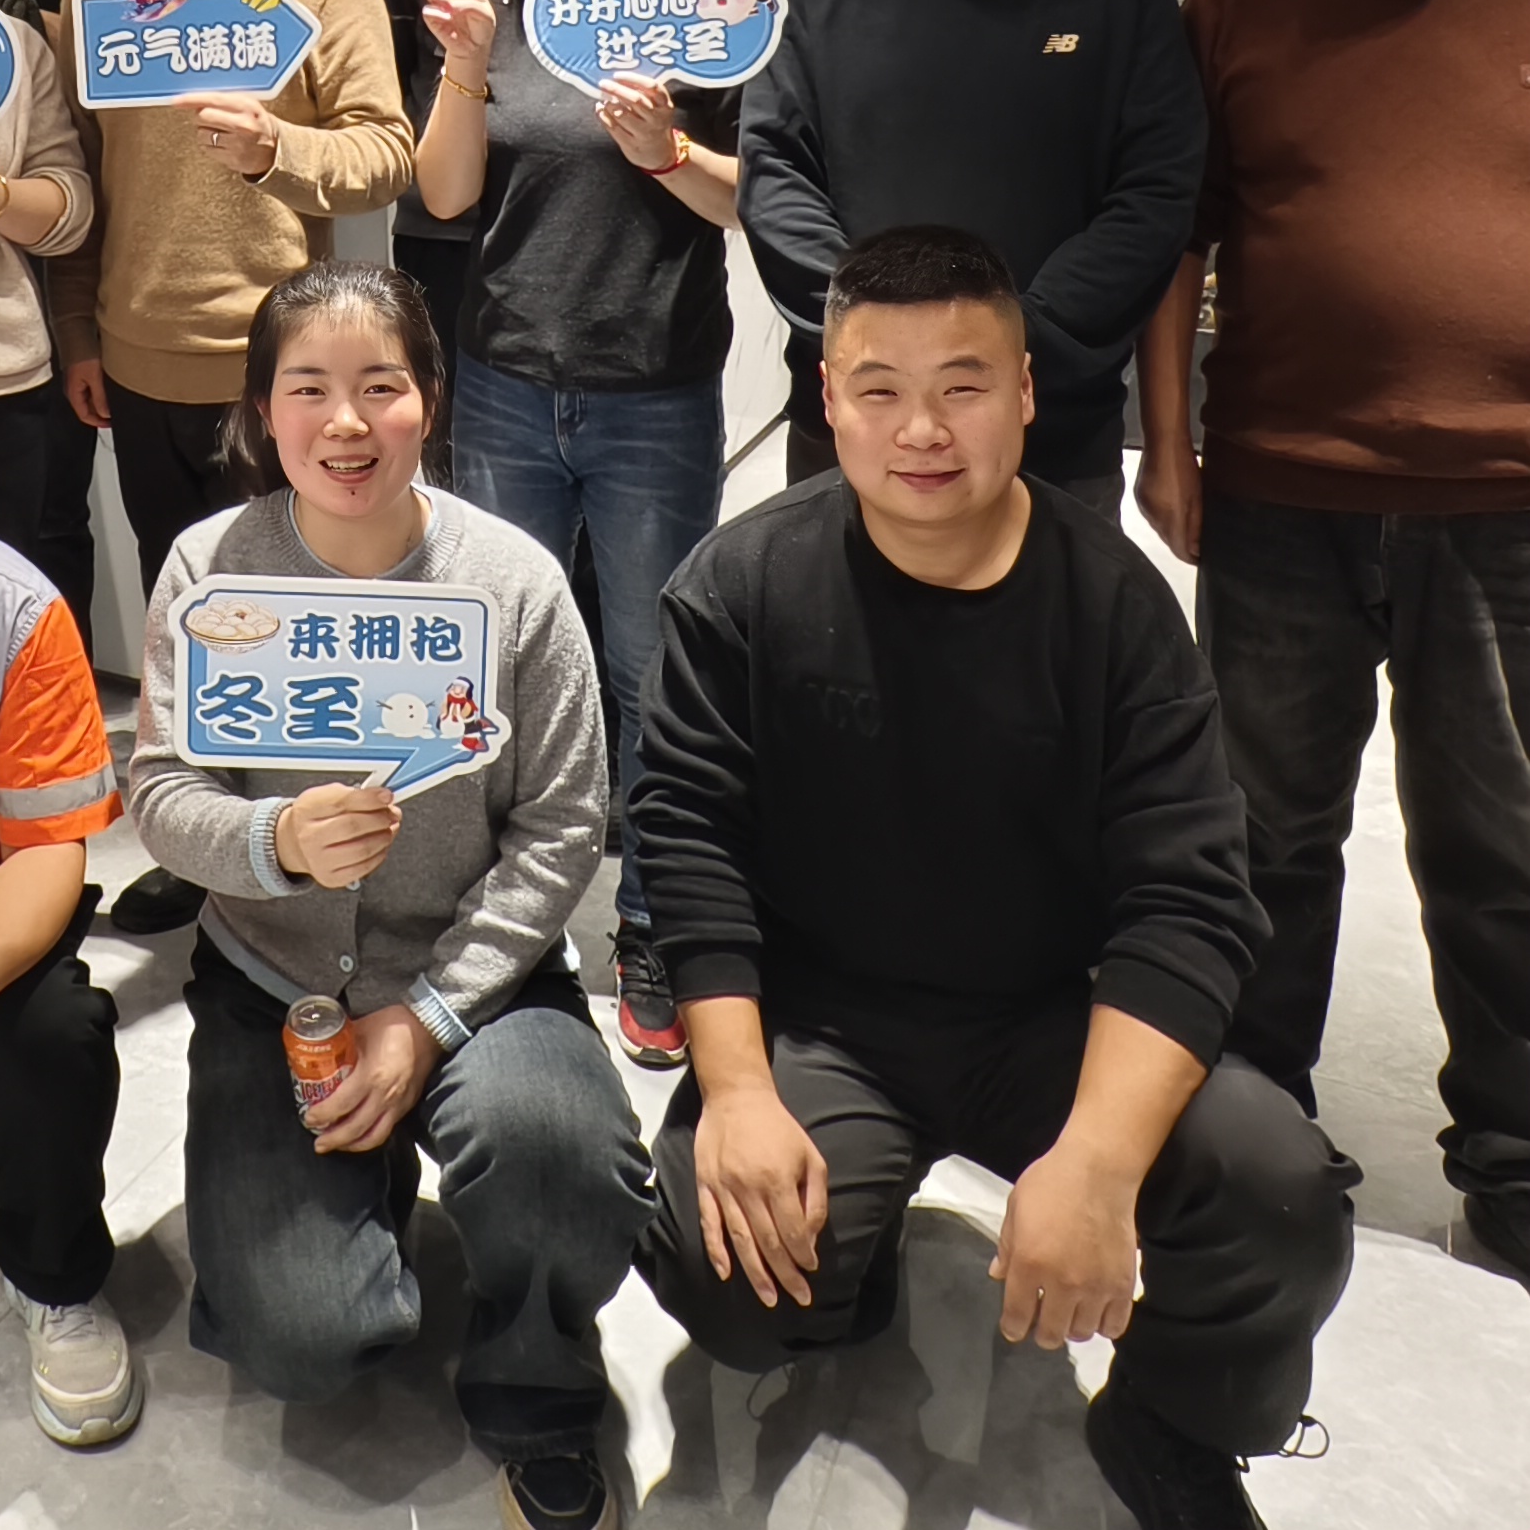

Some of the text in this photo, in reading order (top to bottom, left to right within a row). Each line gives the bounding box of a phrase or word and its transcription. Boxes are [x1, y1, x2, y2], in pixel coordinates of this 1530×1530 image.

[97, 21, 278, 76] 元气满满
[596, 20, 729, 71] 过冬至
[287, 612, 463, 662] 来拥抱
[198, 674, 362, 742] 冬至
